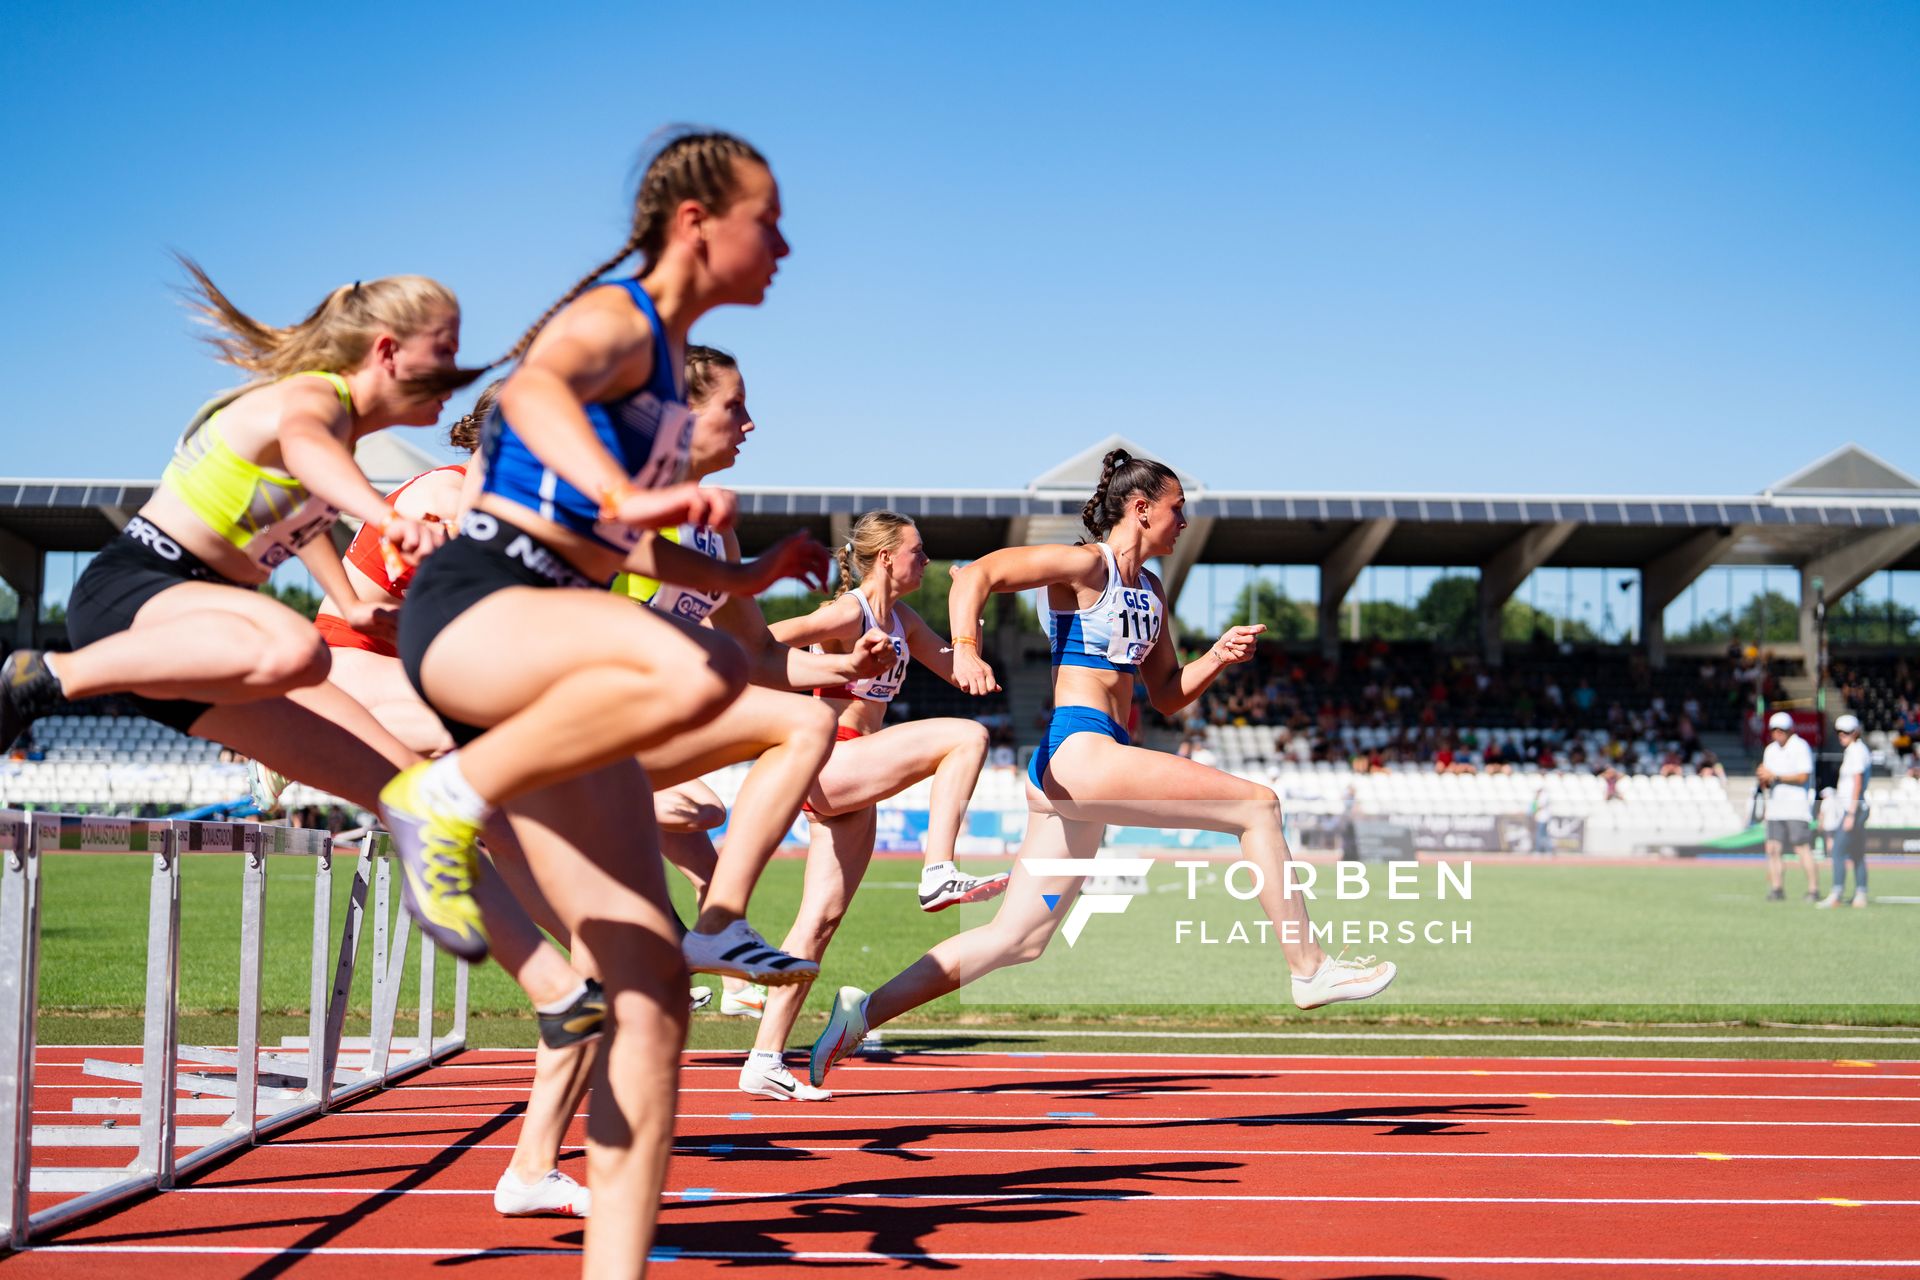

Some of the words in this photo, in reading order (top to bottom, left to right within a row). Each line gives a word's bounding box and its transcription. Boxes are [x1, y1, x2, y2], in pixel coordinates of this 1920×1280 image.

[123, 516, 182, 560] PRO
[1123, 590, 1150, 611] GLS
[1119, 609, 1160, 645] 1112
